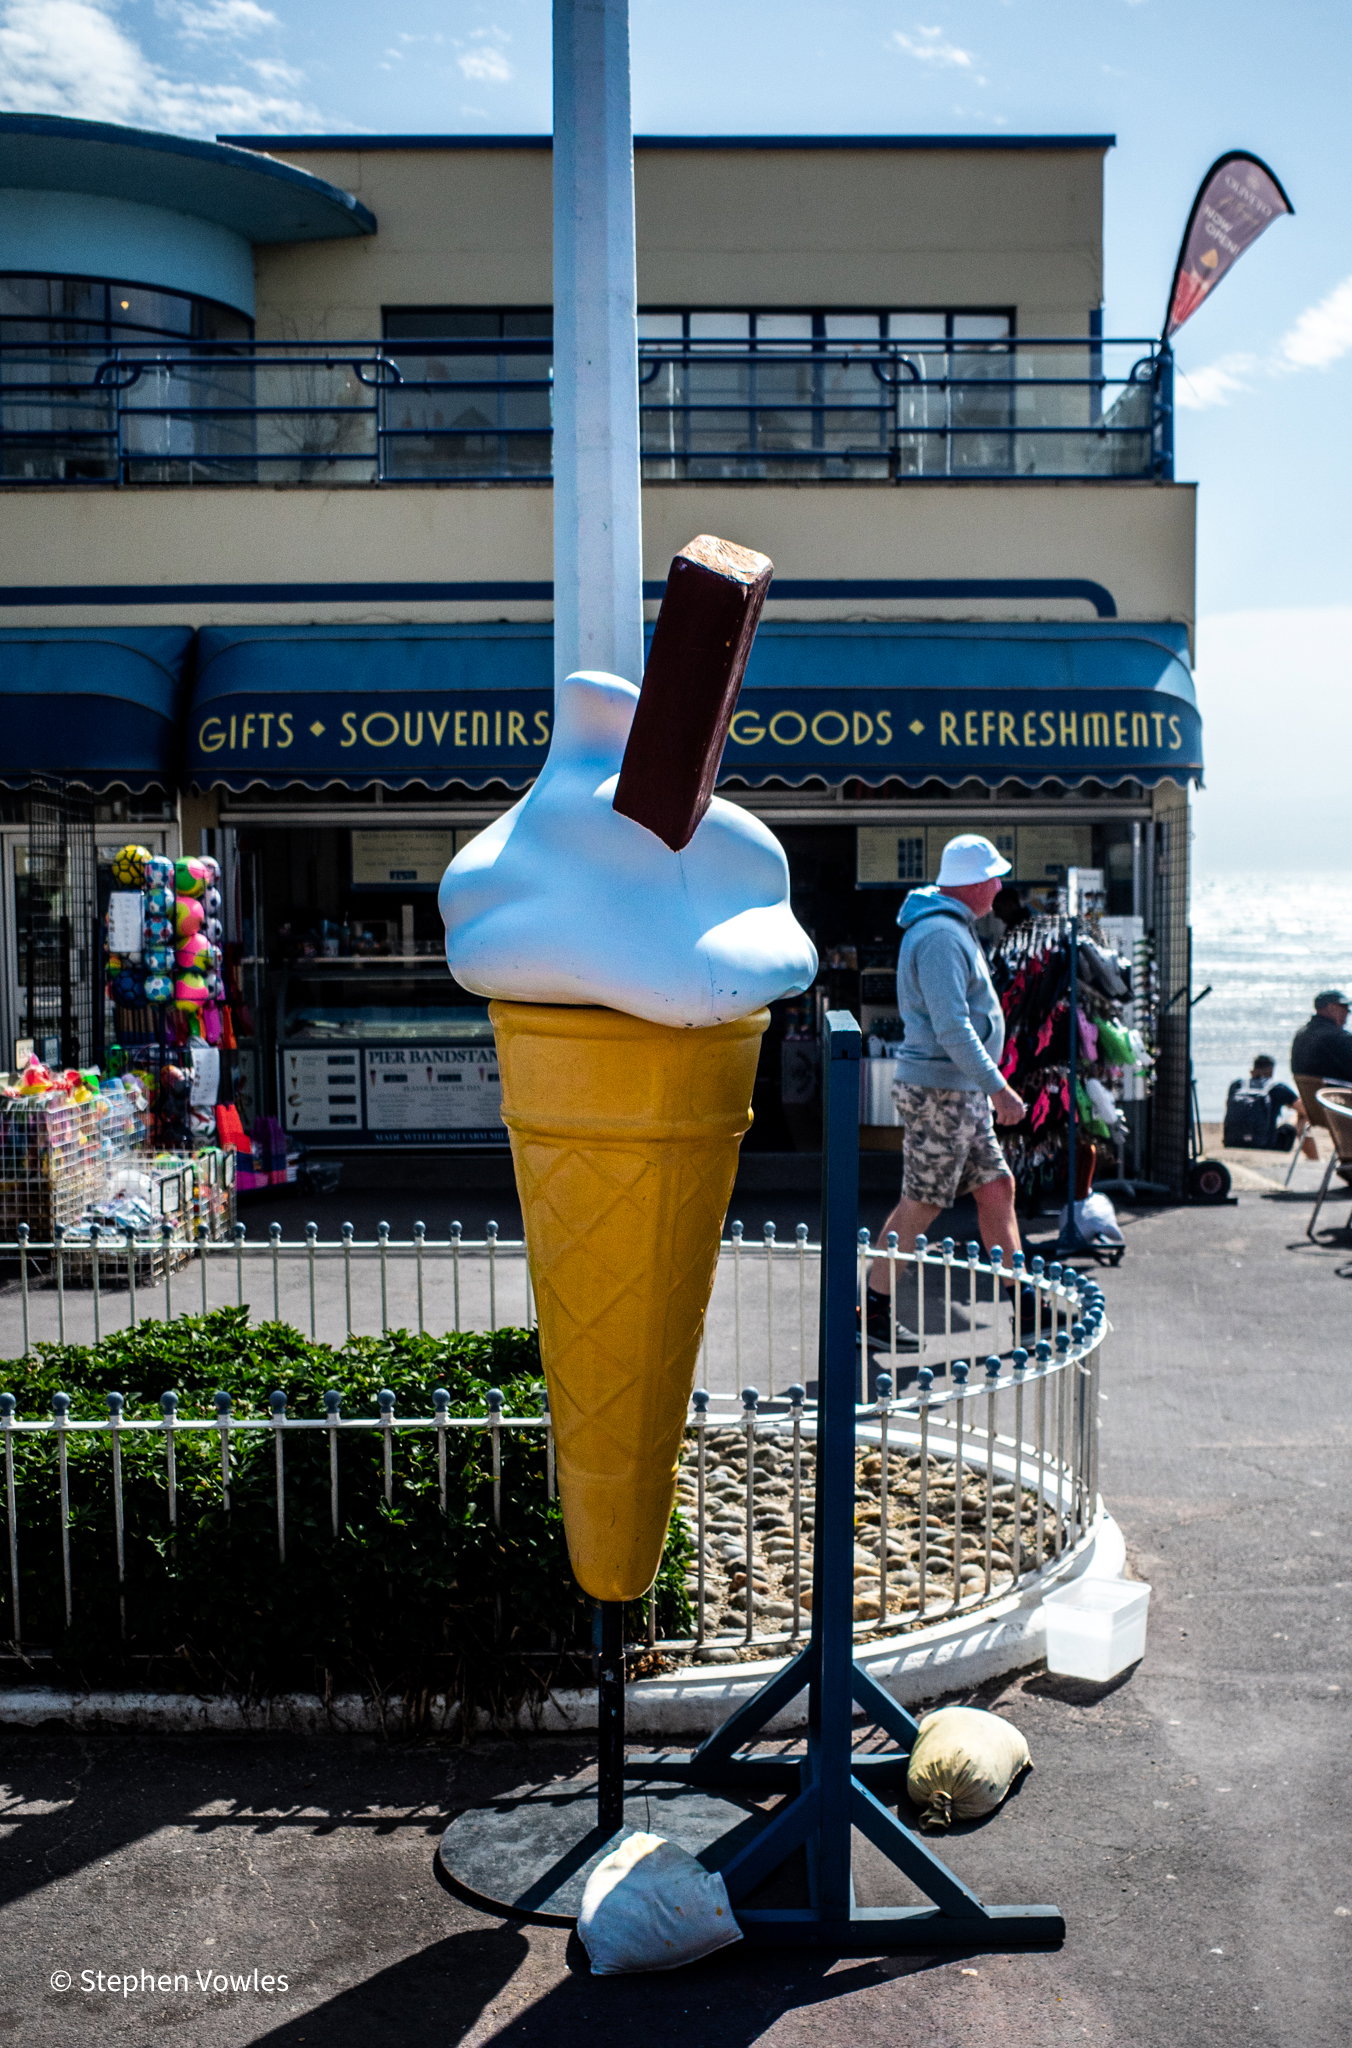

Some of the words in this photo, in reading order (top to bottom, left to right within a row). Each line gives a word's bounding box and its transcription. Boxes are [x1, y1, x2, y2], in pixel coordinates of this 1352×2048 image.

[1204, 203, 1233, 233] NOW
[199, 713, 293, 752] GIFTS
[340, 711, 550, 748] SOUVENIRS
[728, 710, 893, 746] GOODS
[940, 711, 1184, 750] REFRESHMENTS
[369, 1050, 406, 1064] PIER
